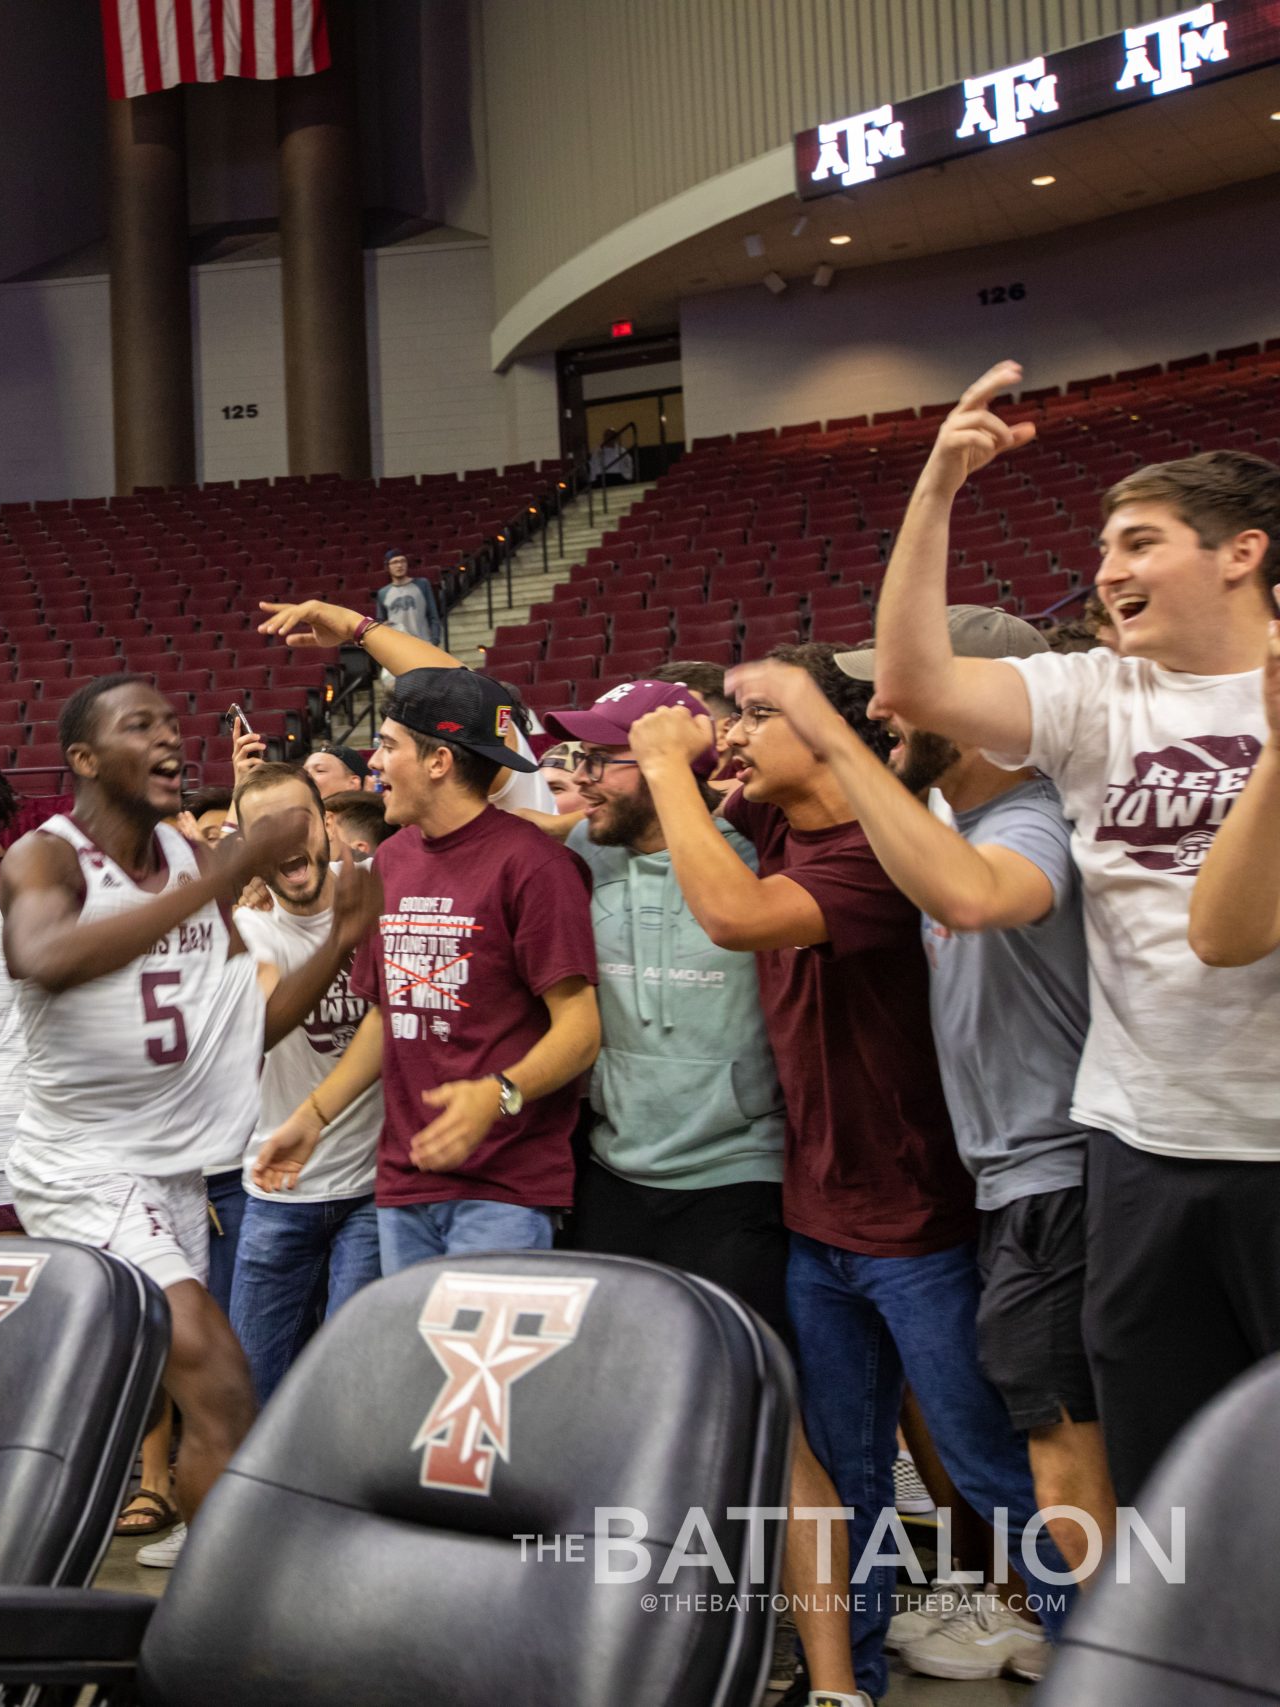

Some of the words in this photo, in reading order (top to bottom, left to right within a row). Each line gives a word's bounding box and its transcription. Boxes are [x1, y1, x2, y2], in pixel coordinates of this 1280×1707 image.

[977, 282, 1026, 306] 126
[221, 403, 259, 420] 125
[1140, 761, 1252, 793] REE
[1101, 786, 1238, 829] ROWD
[379, 914, 409, 935] EXAS
[394, 935, 427, 954] LONG
[438, 937, 461, 957] THE
[383, 953, 434, 980] RANGE
[433, 955, 469, 985] AND
[411, 981, 461, 1012] WHITE
[141, 970, 189, 1067] 5
